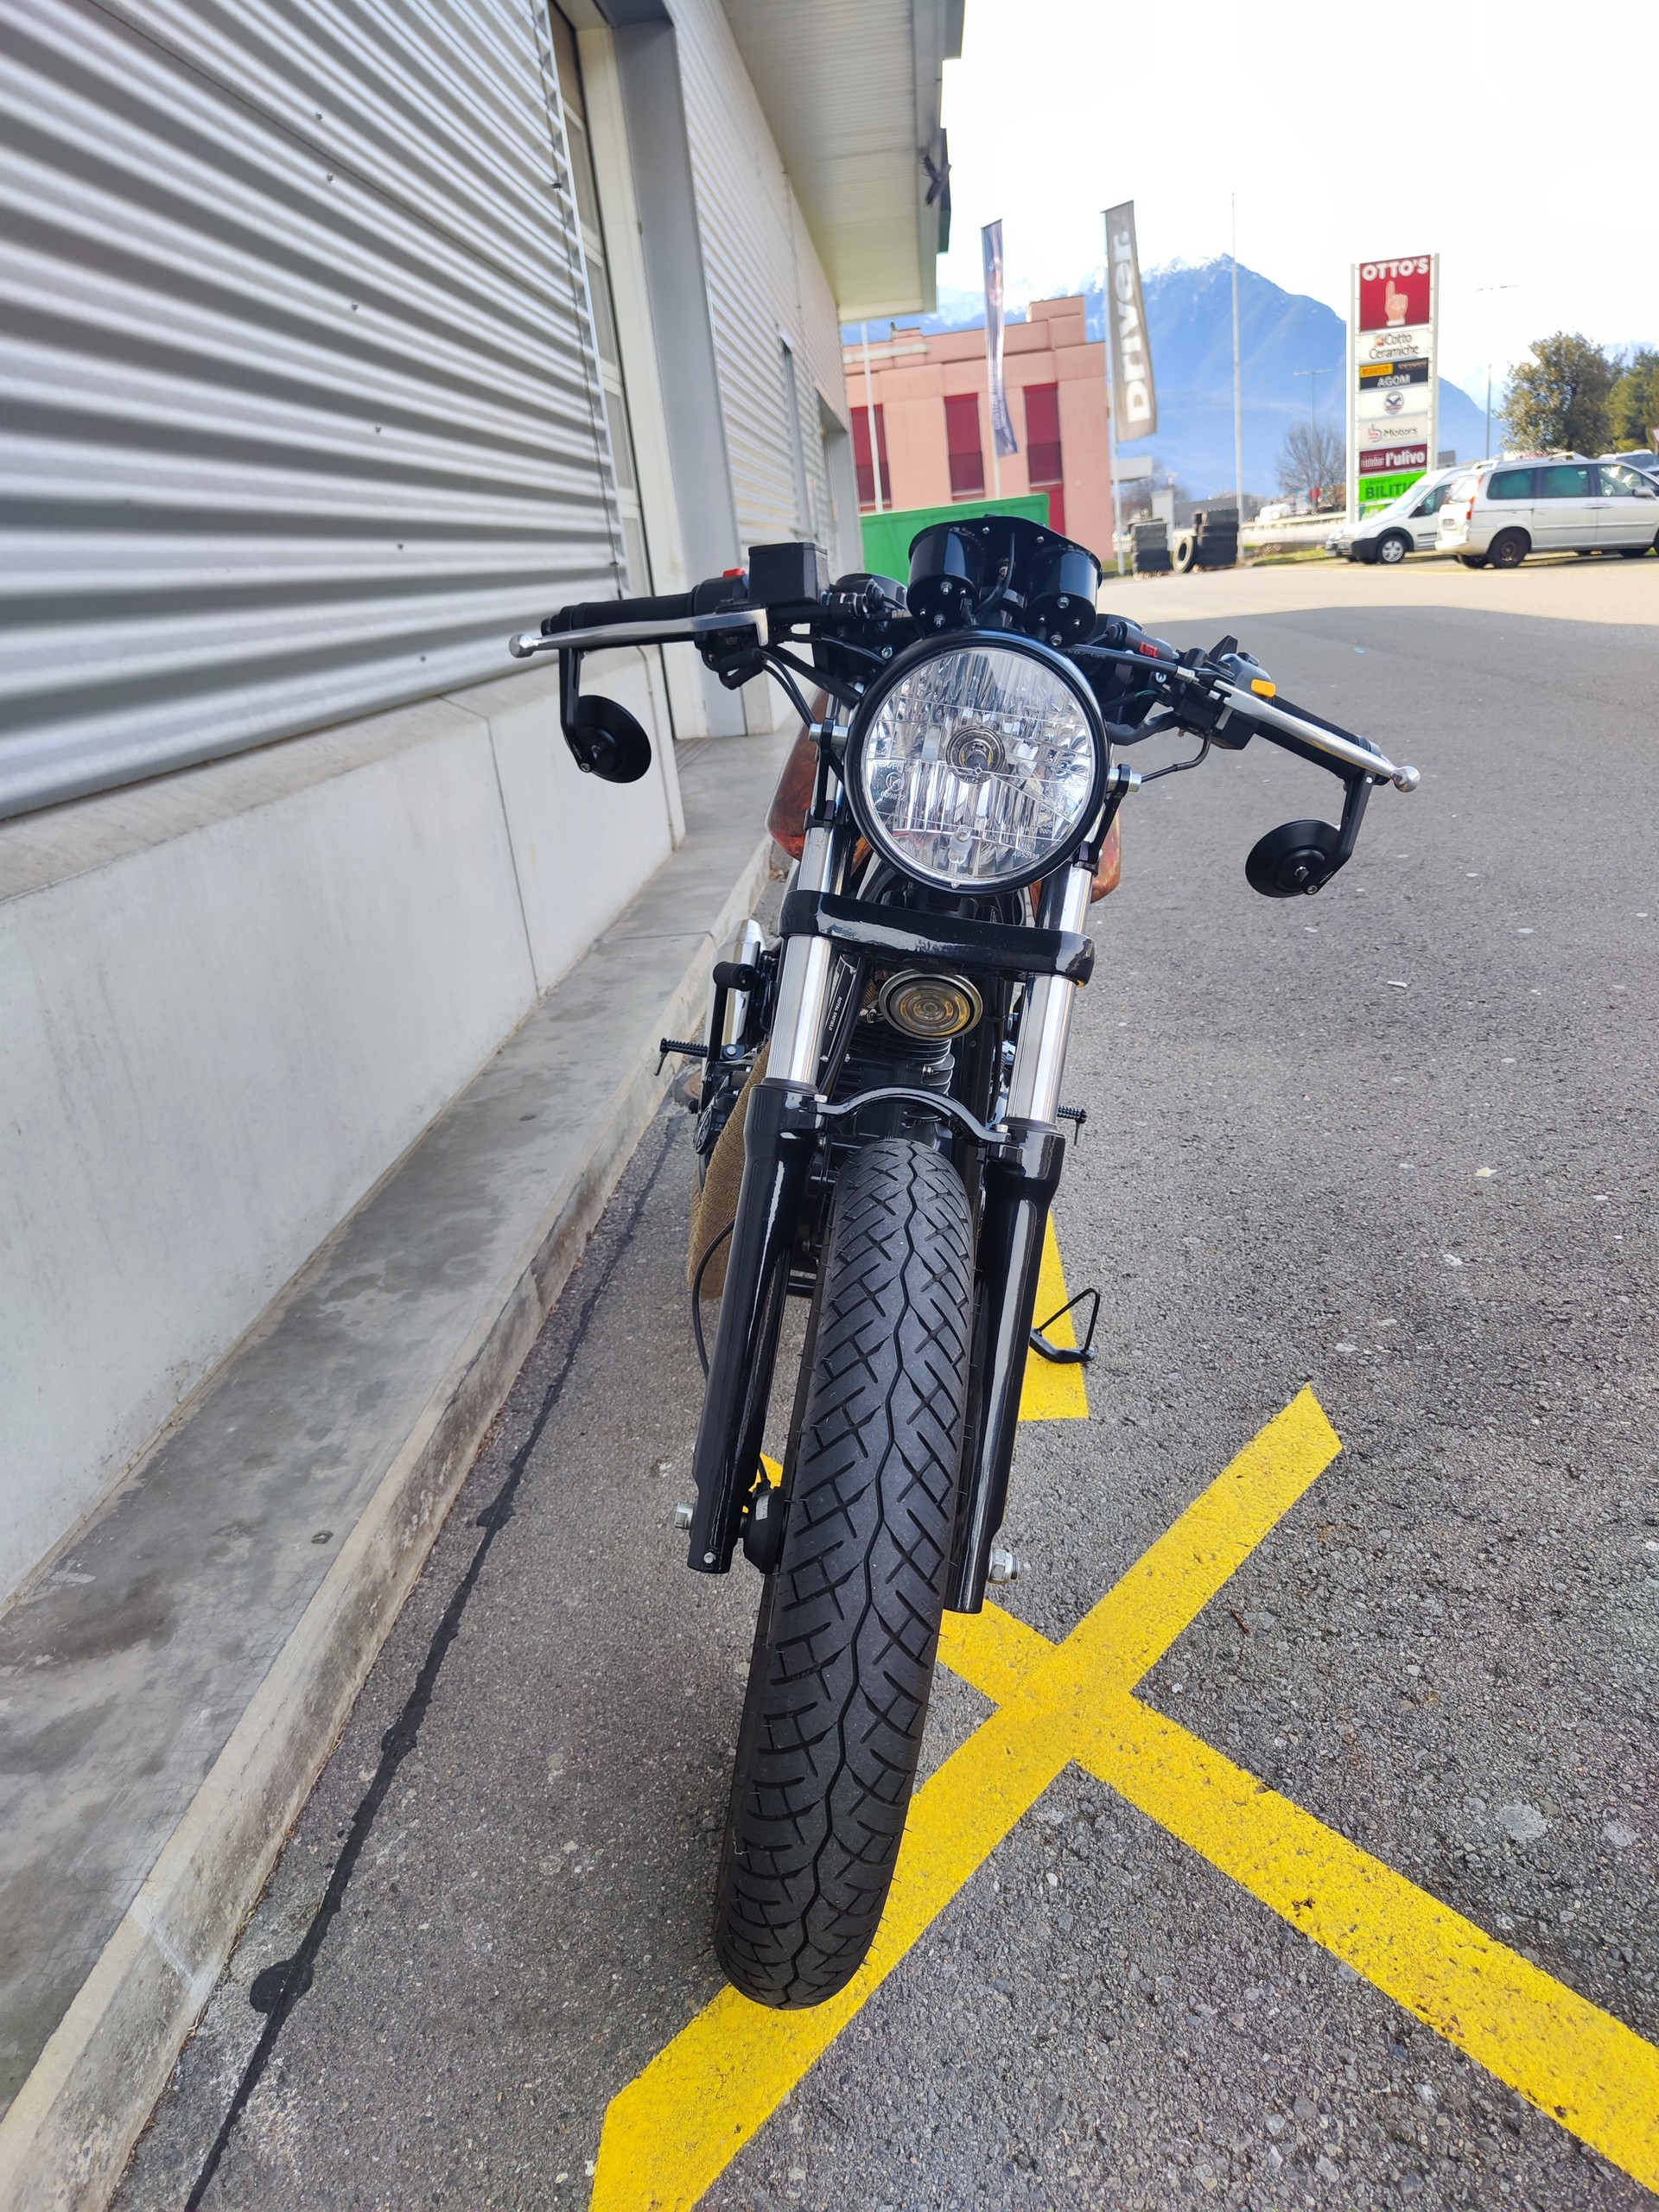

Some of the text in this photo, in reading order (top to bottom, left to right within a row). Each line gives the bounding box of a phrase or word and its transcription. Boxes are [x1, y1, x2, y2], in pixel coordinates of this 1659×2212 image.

[1361, 257, 1429, 282] OTTO'S
[1385, 333, 1413, 346] Cotto
[1369, 344, 1420, 359] Ceramiche
[1377, 373, 1411, 387] AGOM
[829, 1012, 837, 1031] ENFIELD
